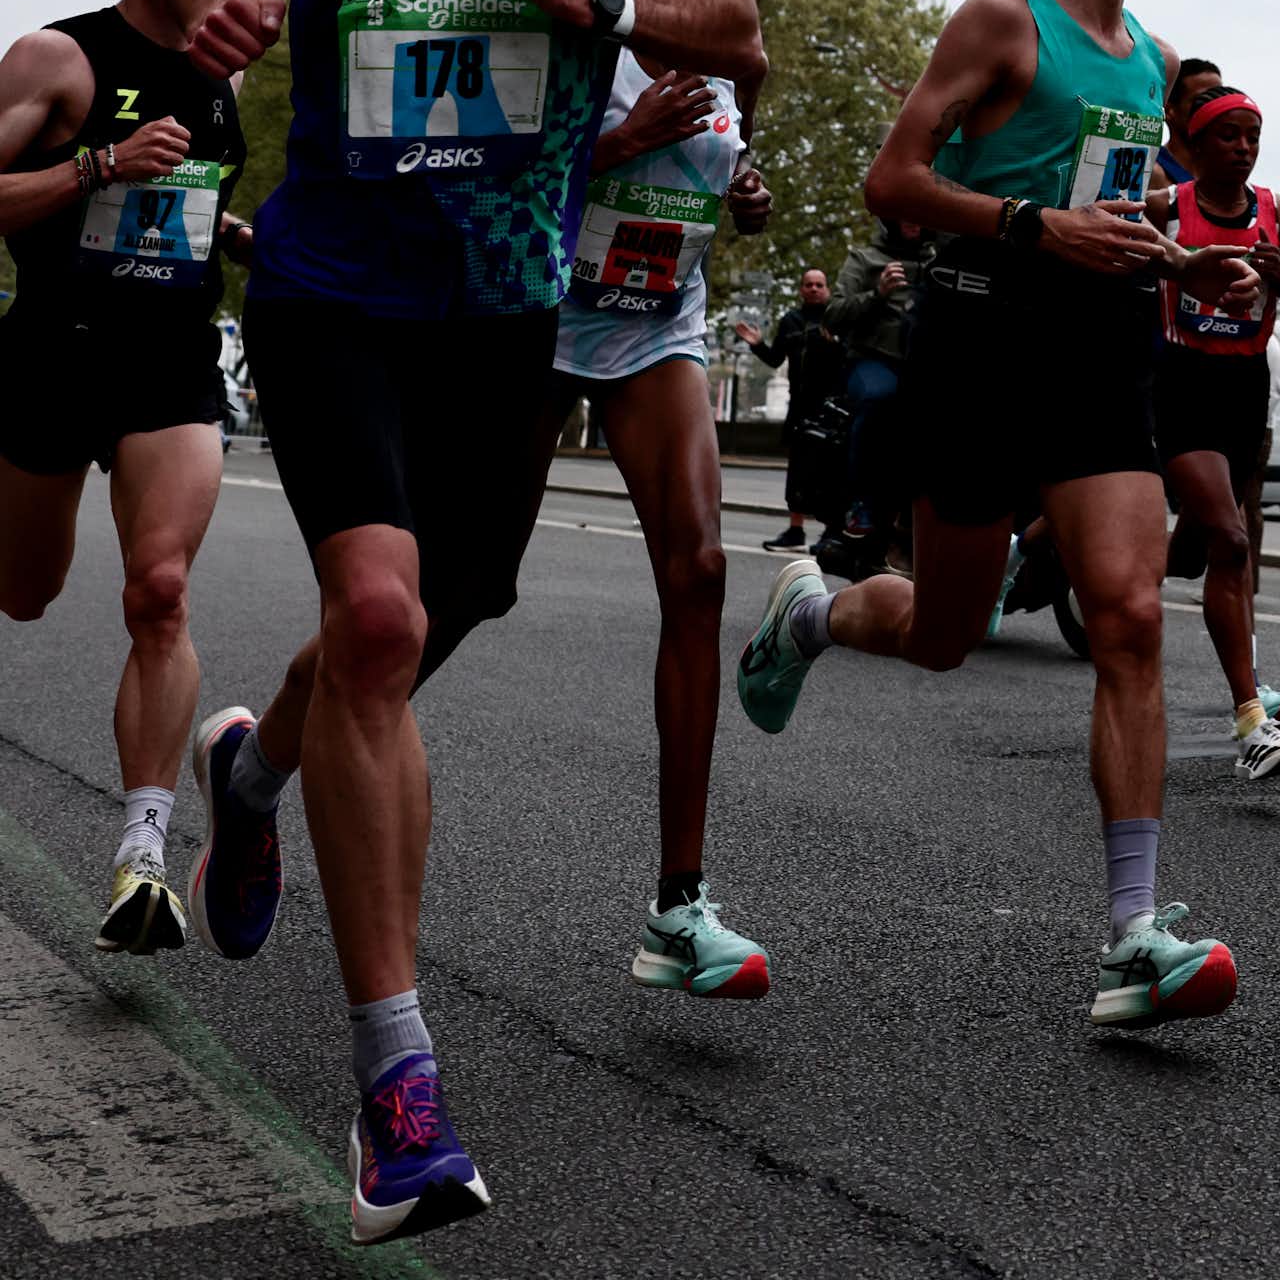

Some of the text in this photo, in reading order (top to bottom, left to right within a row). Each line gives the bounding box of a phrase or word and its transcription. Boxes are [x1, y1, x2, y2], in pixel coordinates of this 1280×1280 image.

[452, 13, 522, 28] Electric
[407, 39, 484, 99] 178
[425, 147, 486, 168] asics
[173, 160, 209, 177] eider
[1111, 147, 1146, 192] 182
[627, 185, 708, 210] Schneider
[137, 189, 177, 230] 97
[660, 206, 704, 220] Electric
[133, 264, 175, 280] asics
[572, 257, 599, 280] 206
[617, 297, 662, 312] asics
[1212, 321, 1240, 334] asics
